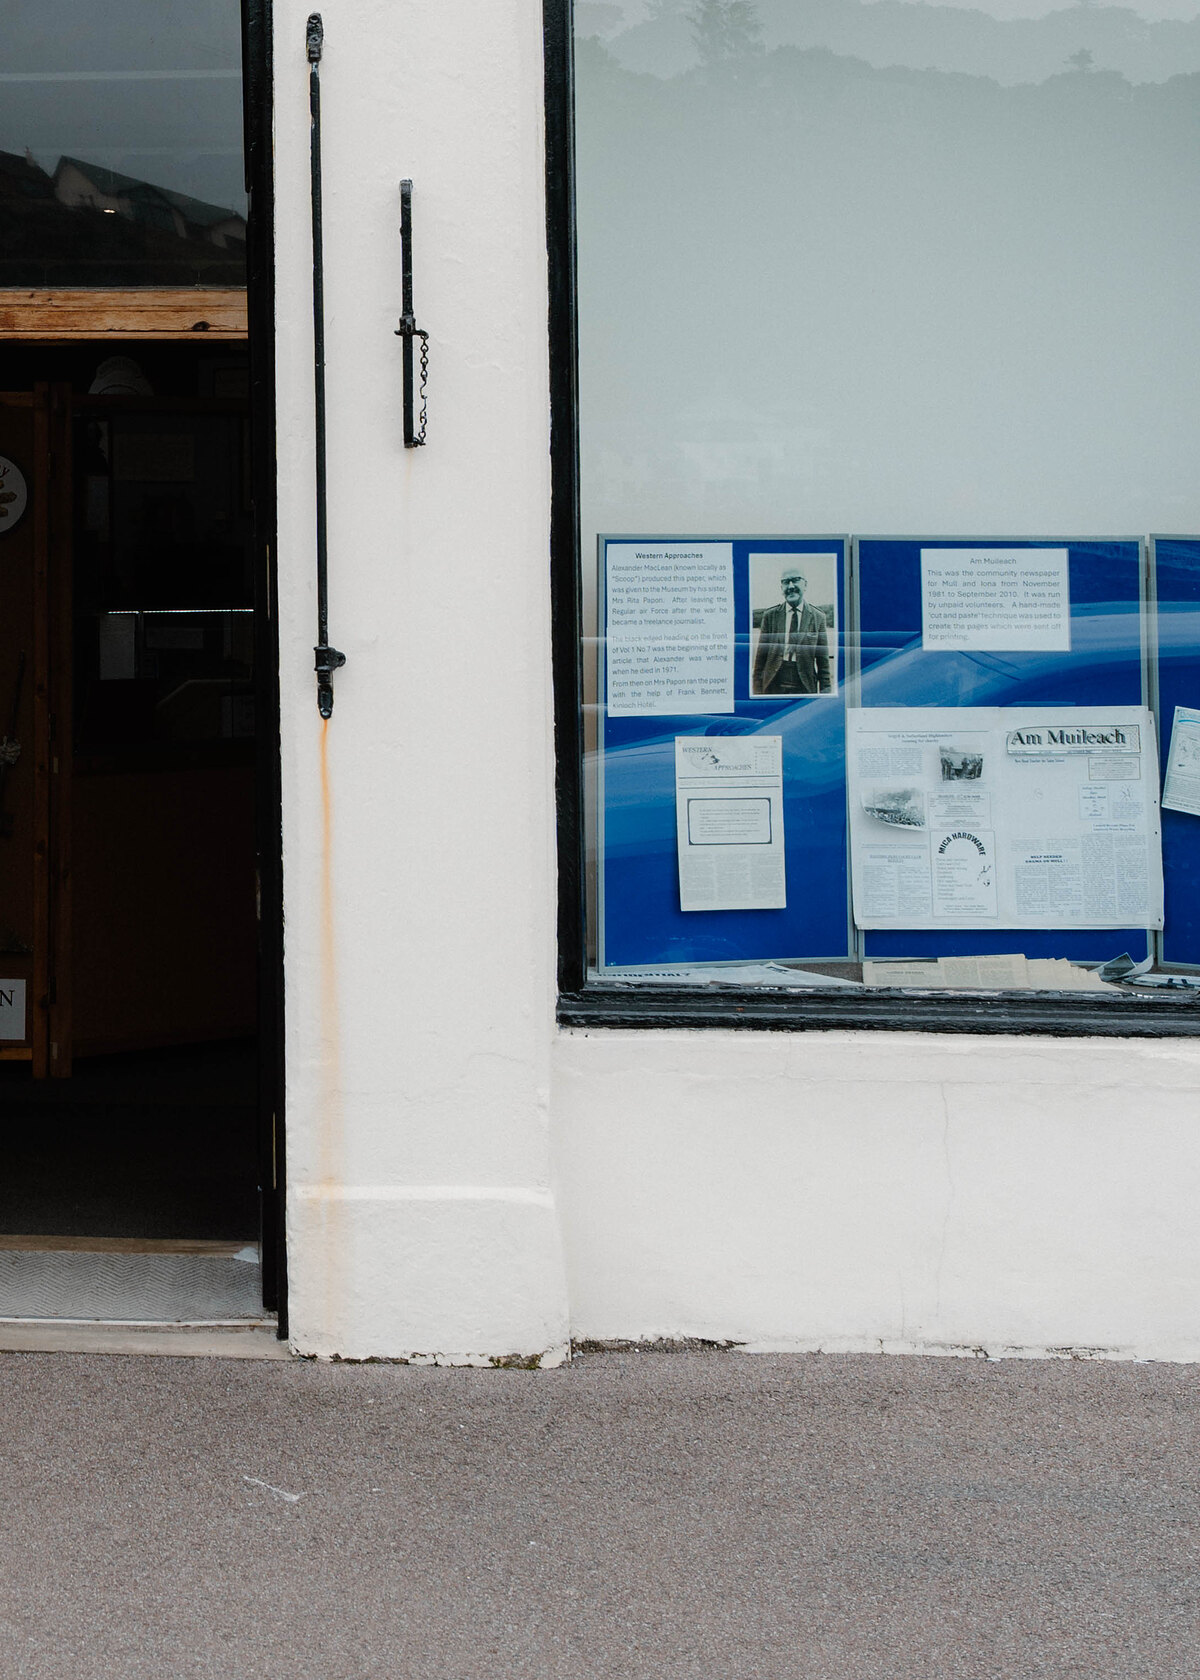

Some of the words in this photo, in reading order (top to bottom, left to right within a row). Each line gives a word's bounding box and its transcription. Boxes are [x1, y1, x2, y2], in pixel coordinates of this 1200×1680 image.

[698, 564, 717, 572] locally
[612, 608, 635, 616] Regular
[678, 645, 708, 653] beginning
[1011, 731, 1041, 745] Am
[1047, 729, 1125, 744] Muileach
[938, 836, 952, 854] MICA
[952, 832, 986, 856] HARDWARE
